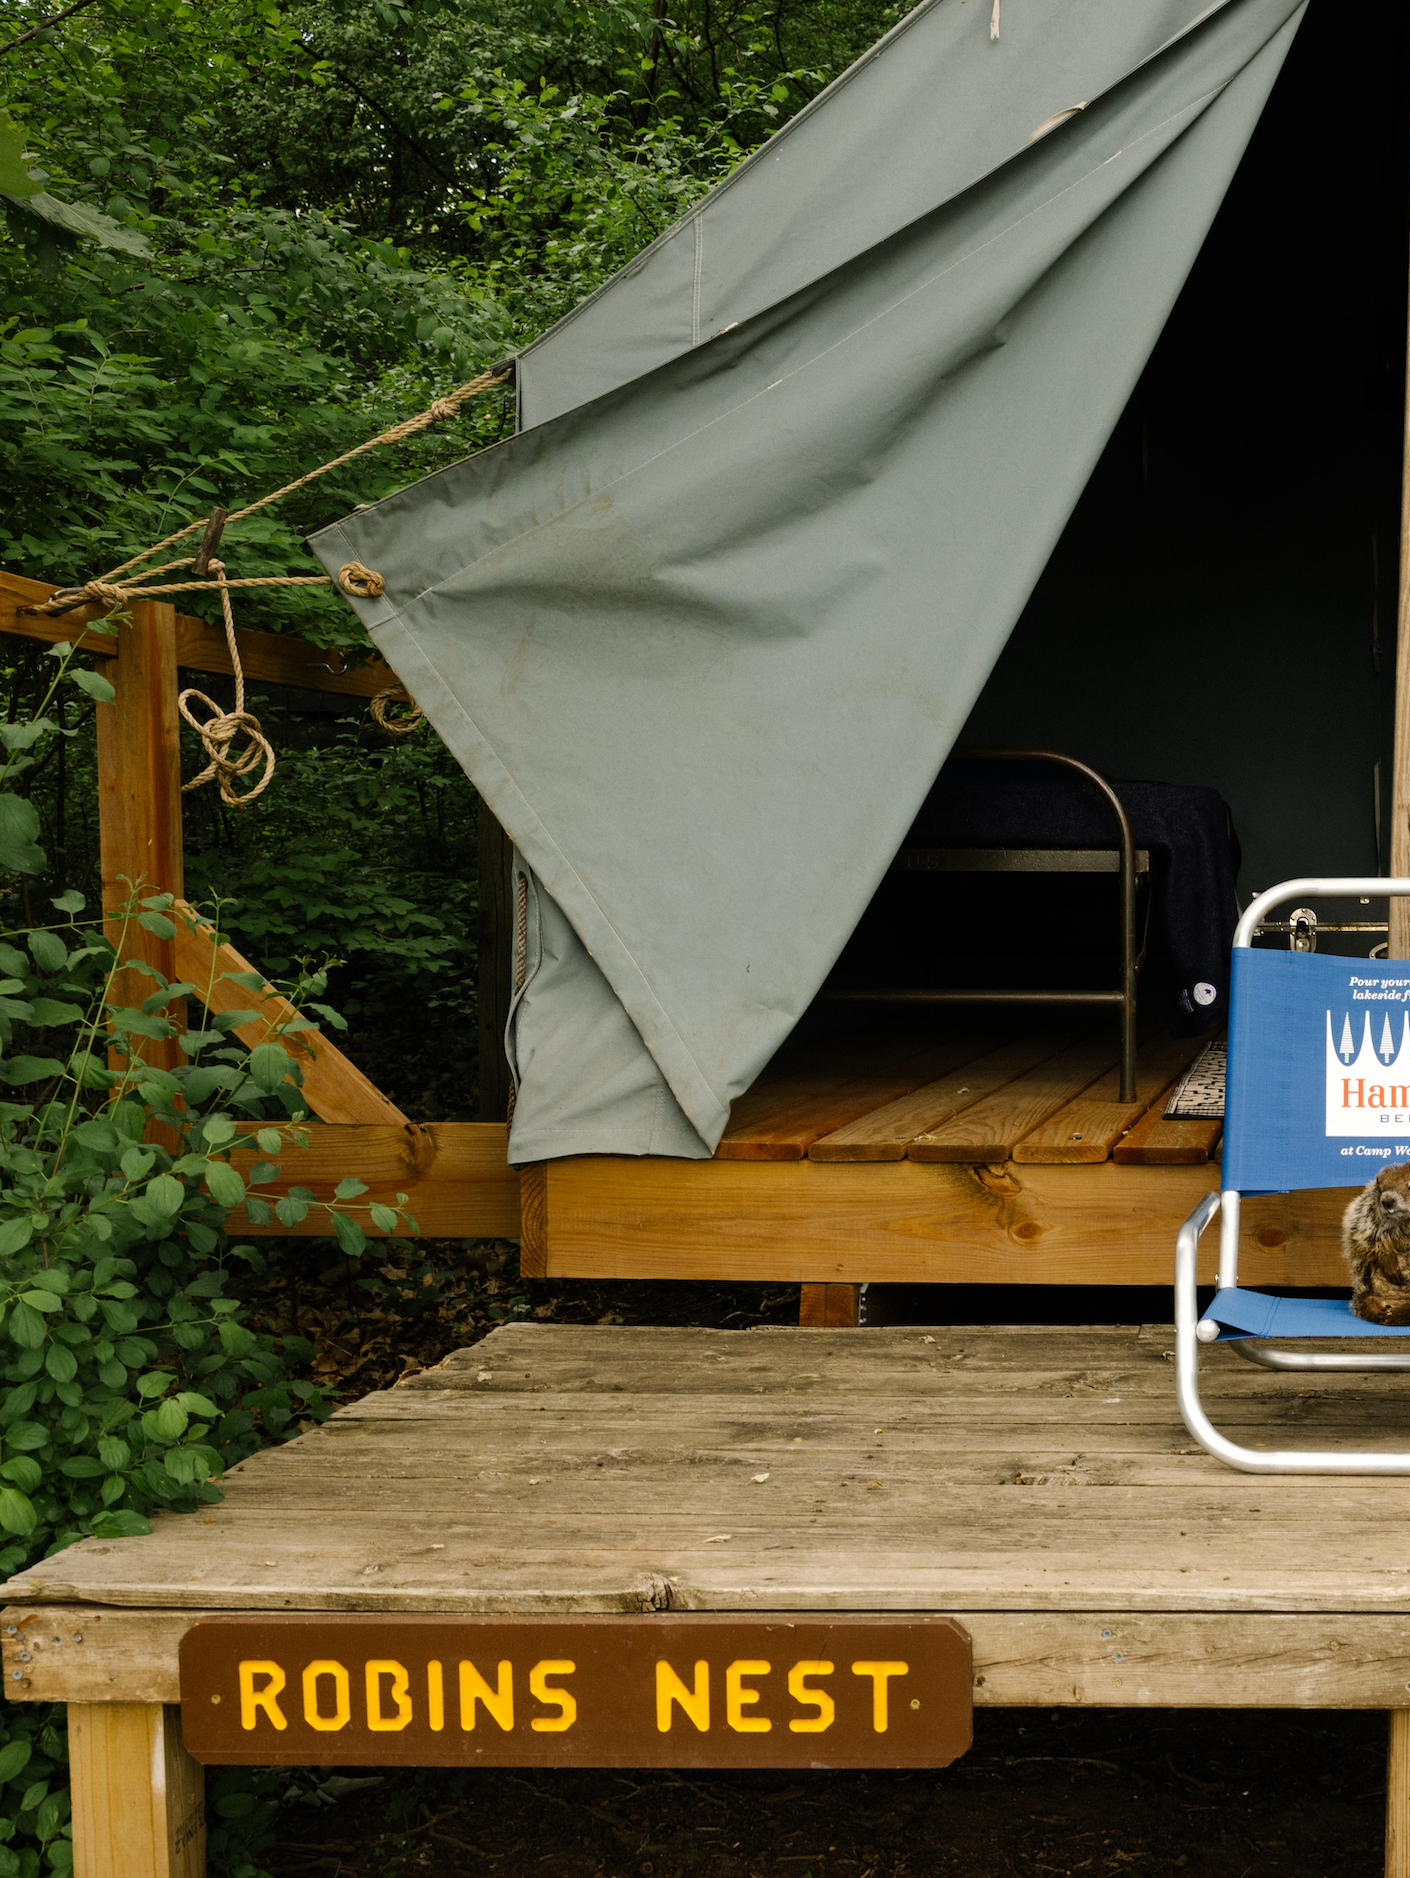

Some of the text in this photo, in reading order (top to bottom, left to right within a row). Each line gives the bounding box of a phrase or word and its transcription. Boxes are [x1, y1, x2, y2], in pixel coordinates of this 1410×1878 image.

[1349, 976, 1379, 987] Pour
[1352, 989, 1401, 1000] lakeside
[1340, 1146, 1354, 1156] at
[1355, 1145, 1392, 1158] Camp
[238, 1658, 909, 1733] ROBINS NEST
